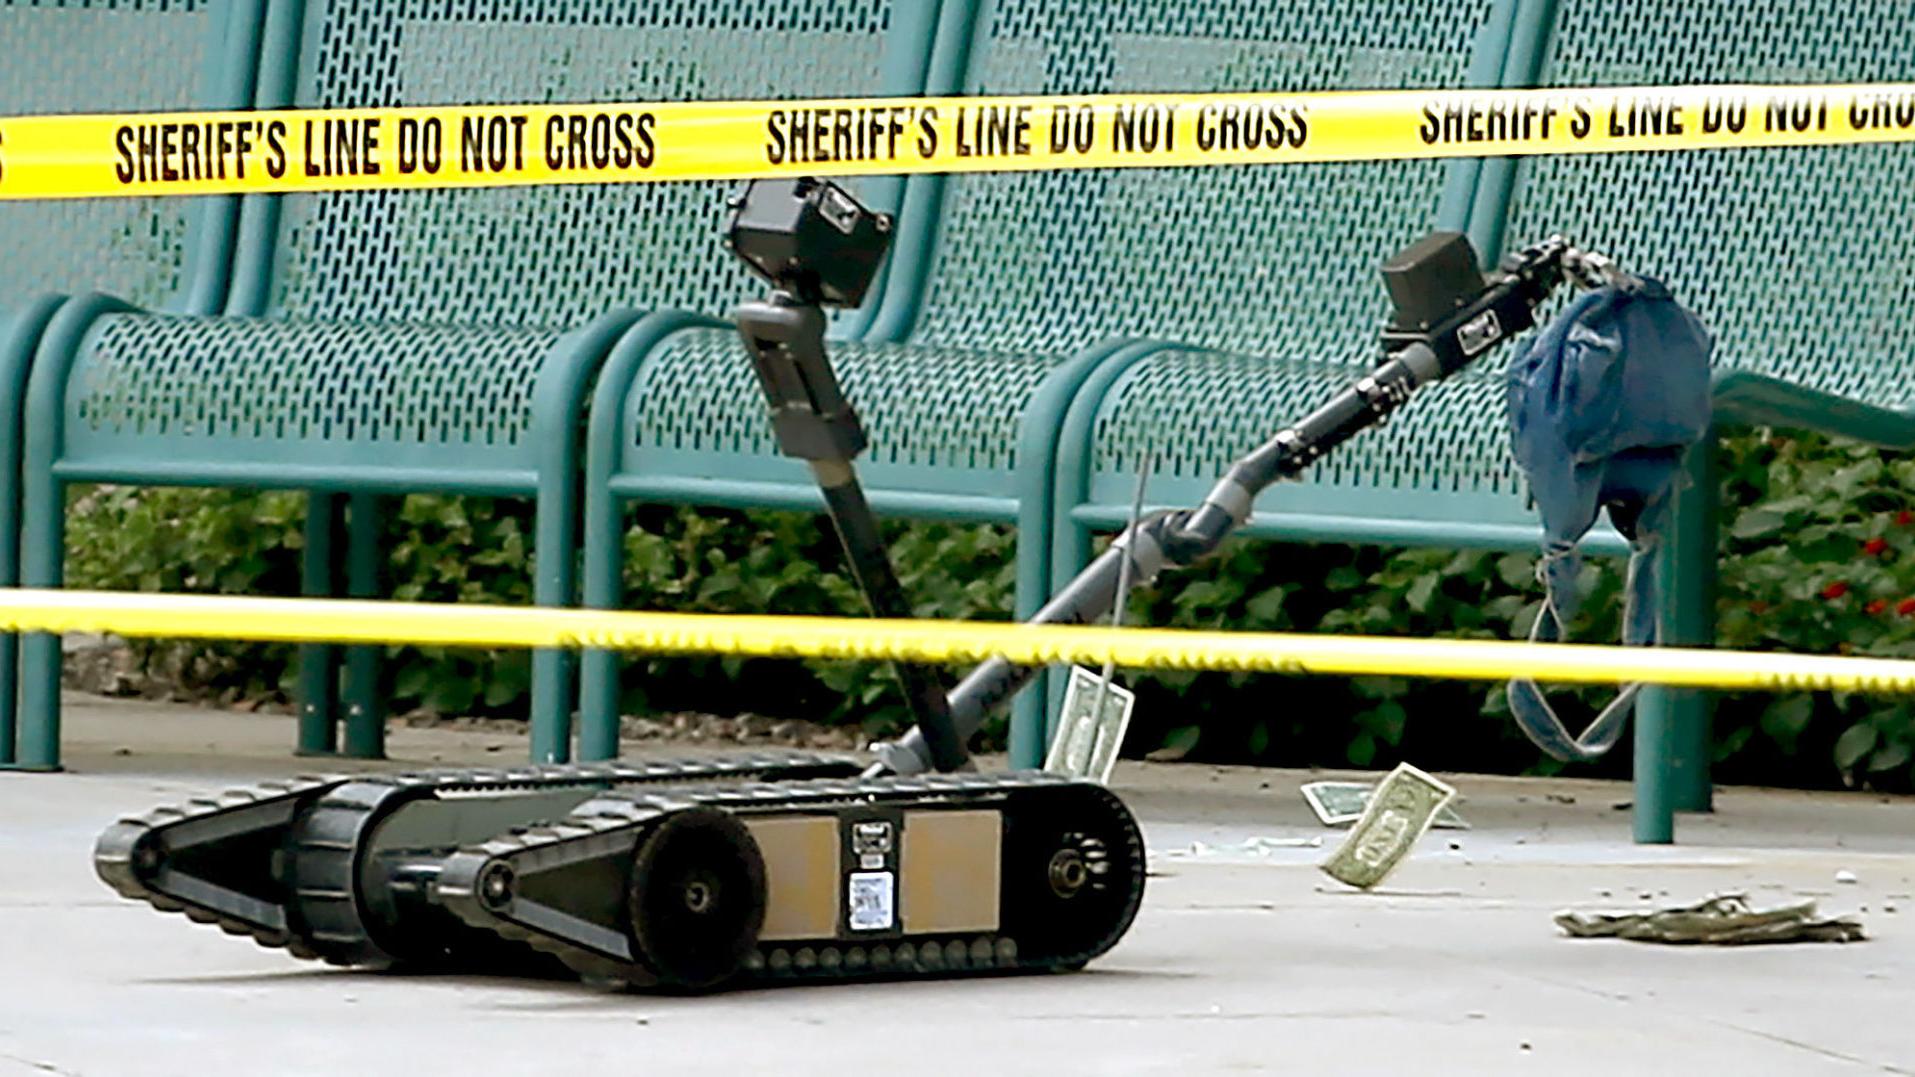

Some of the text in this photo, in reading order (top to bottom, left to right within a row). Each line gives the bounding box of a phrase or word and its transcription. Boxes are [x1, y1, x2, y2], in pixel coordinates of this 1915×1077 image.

[115, 113, 656, 183] SHERIFF'S LINE DO NOT CROSS
[766, 103, 1309, 164] SHERIFF'S LINE DO NOT CROSS
[1419, 97, 1592, 145] SHERIFFS
[1609, 95, 1684, 138] LINE
[1702, 95, 1747, 134] DO
[1765, 93, 1828, 132] NOT
